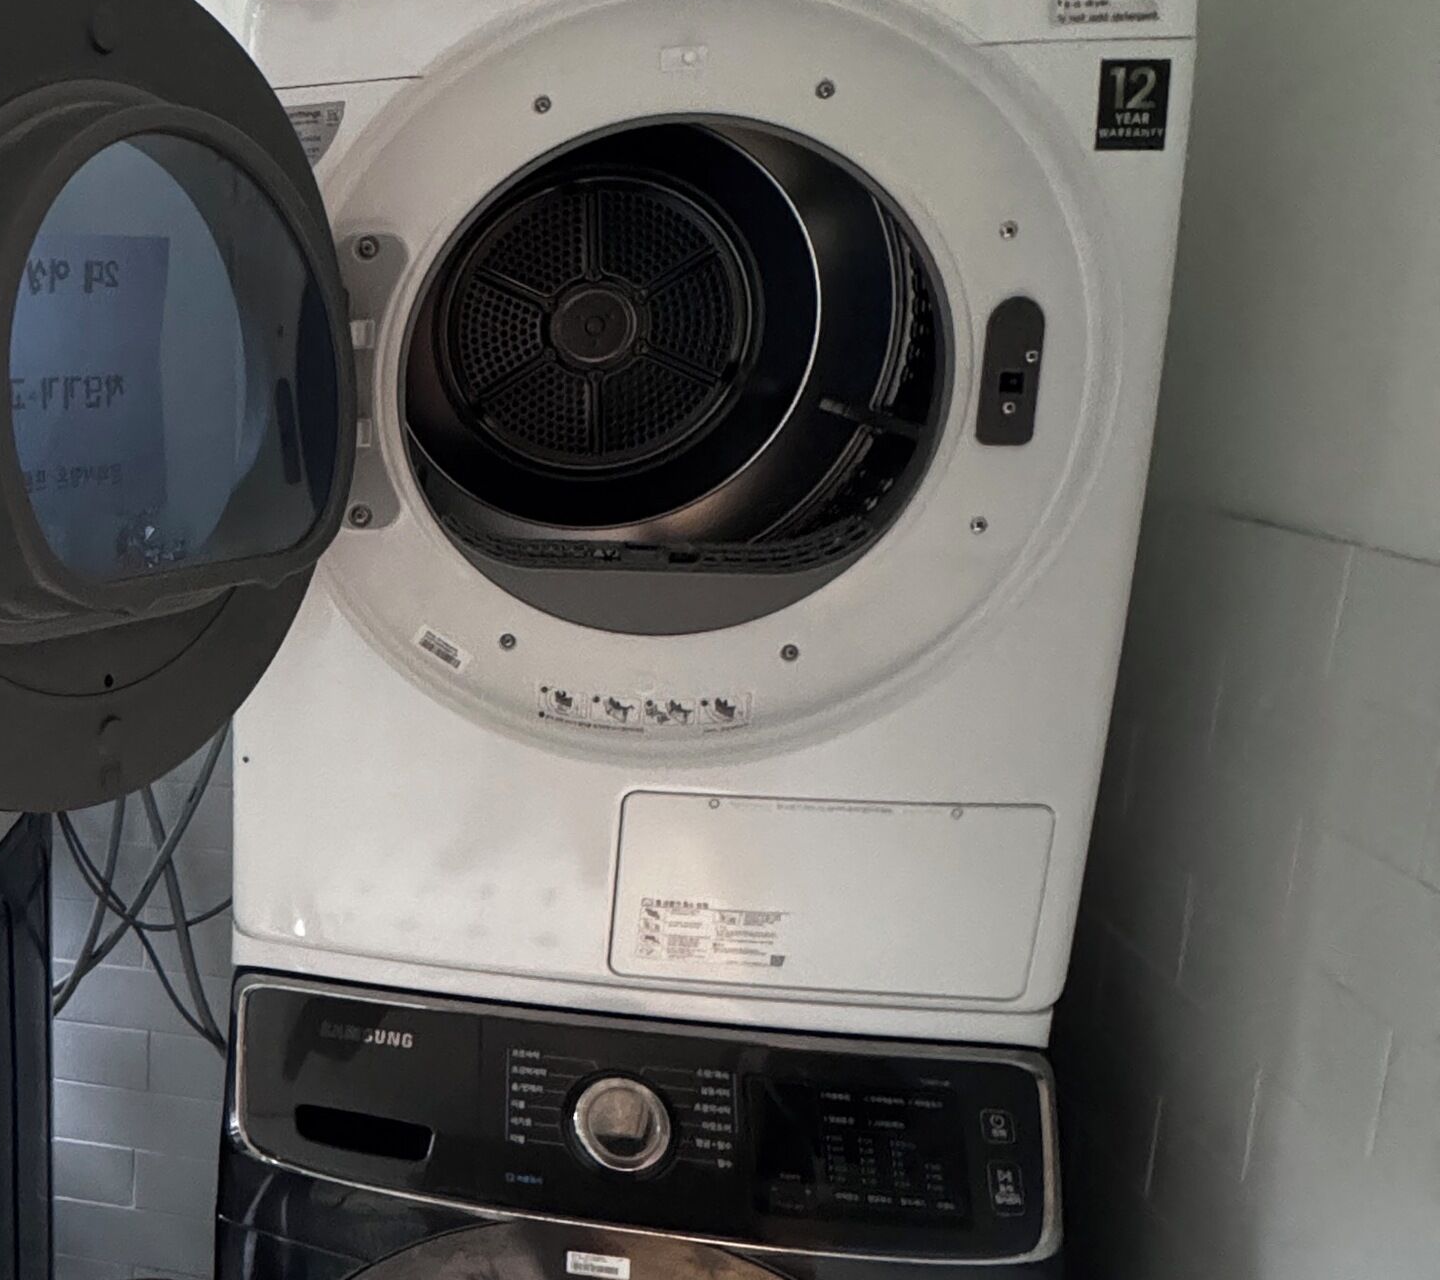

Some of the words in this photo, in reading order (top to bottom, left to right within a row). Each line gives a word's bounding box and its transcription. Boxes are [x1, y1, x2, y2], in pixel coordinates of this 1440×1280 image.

[1110, 66, 1157, 110] 12
[1115, 112, 1150, 126] YEAR
[1099, 126, 1164, 138] WARRANTY
